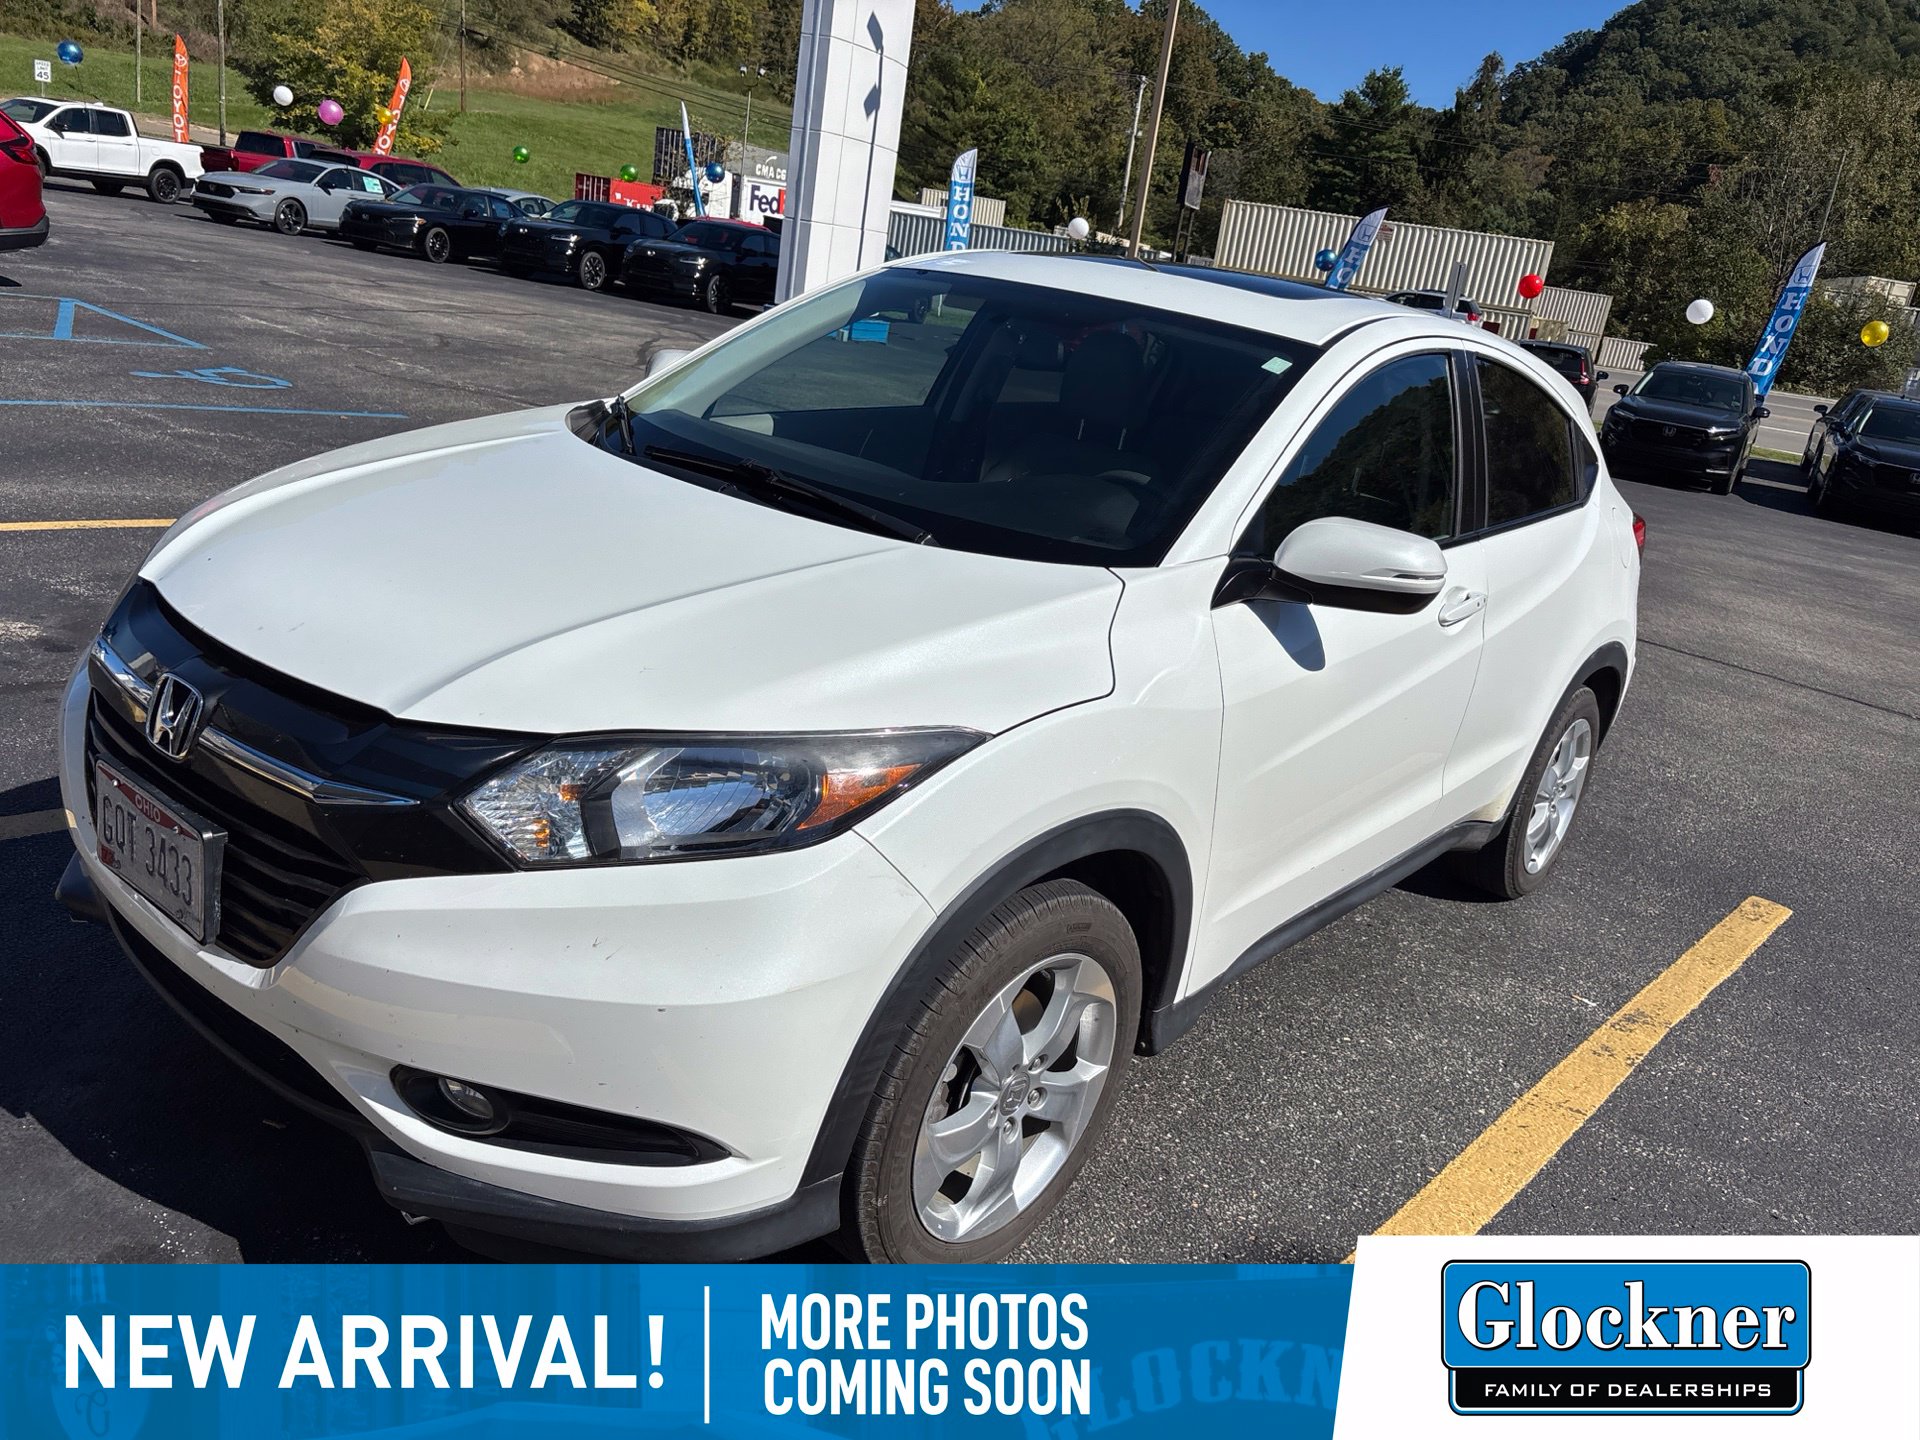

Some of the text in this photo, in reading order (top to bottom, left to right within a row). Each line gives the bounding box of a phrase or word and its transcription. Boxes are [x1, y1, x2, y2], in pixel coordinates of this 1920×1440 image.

[36, 71, 49, 80] 45
[756, 163, 774, 179] CMA
[1330, 246, 1368, 289] HO
[1749, 292, 1806, 394] HOND
[135, 794, 160, 823] OHIO
[145, 826, 192, 906] 3433
